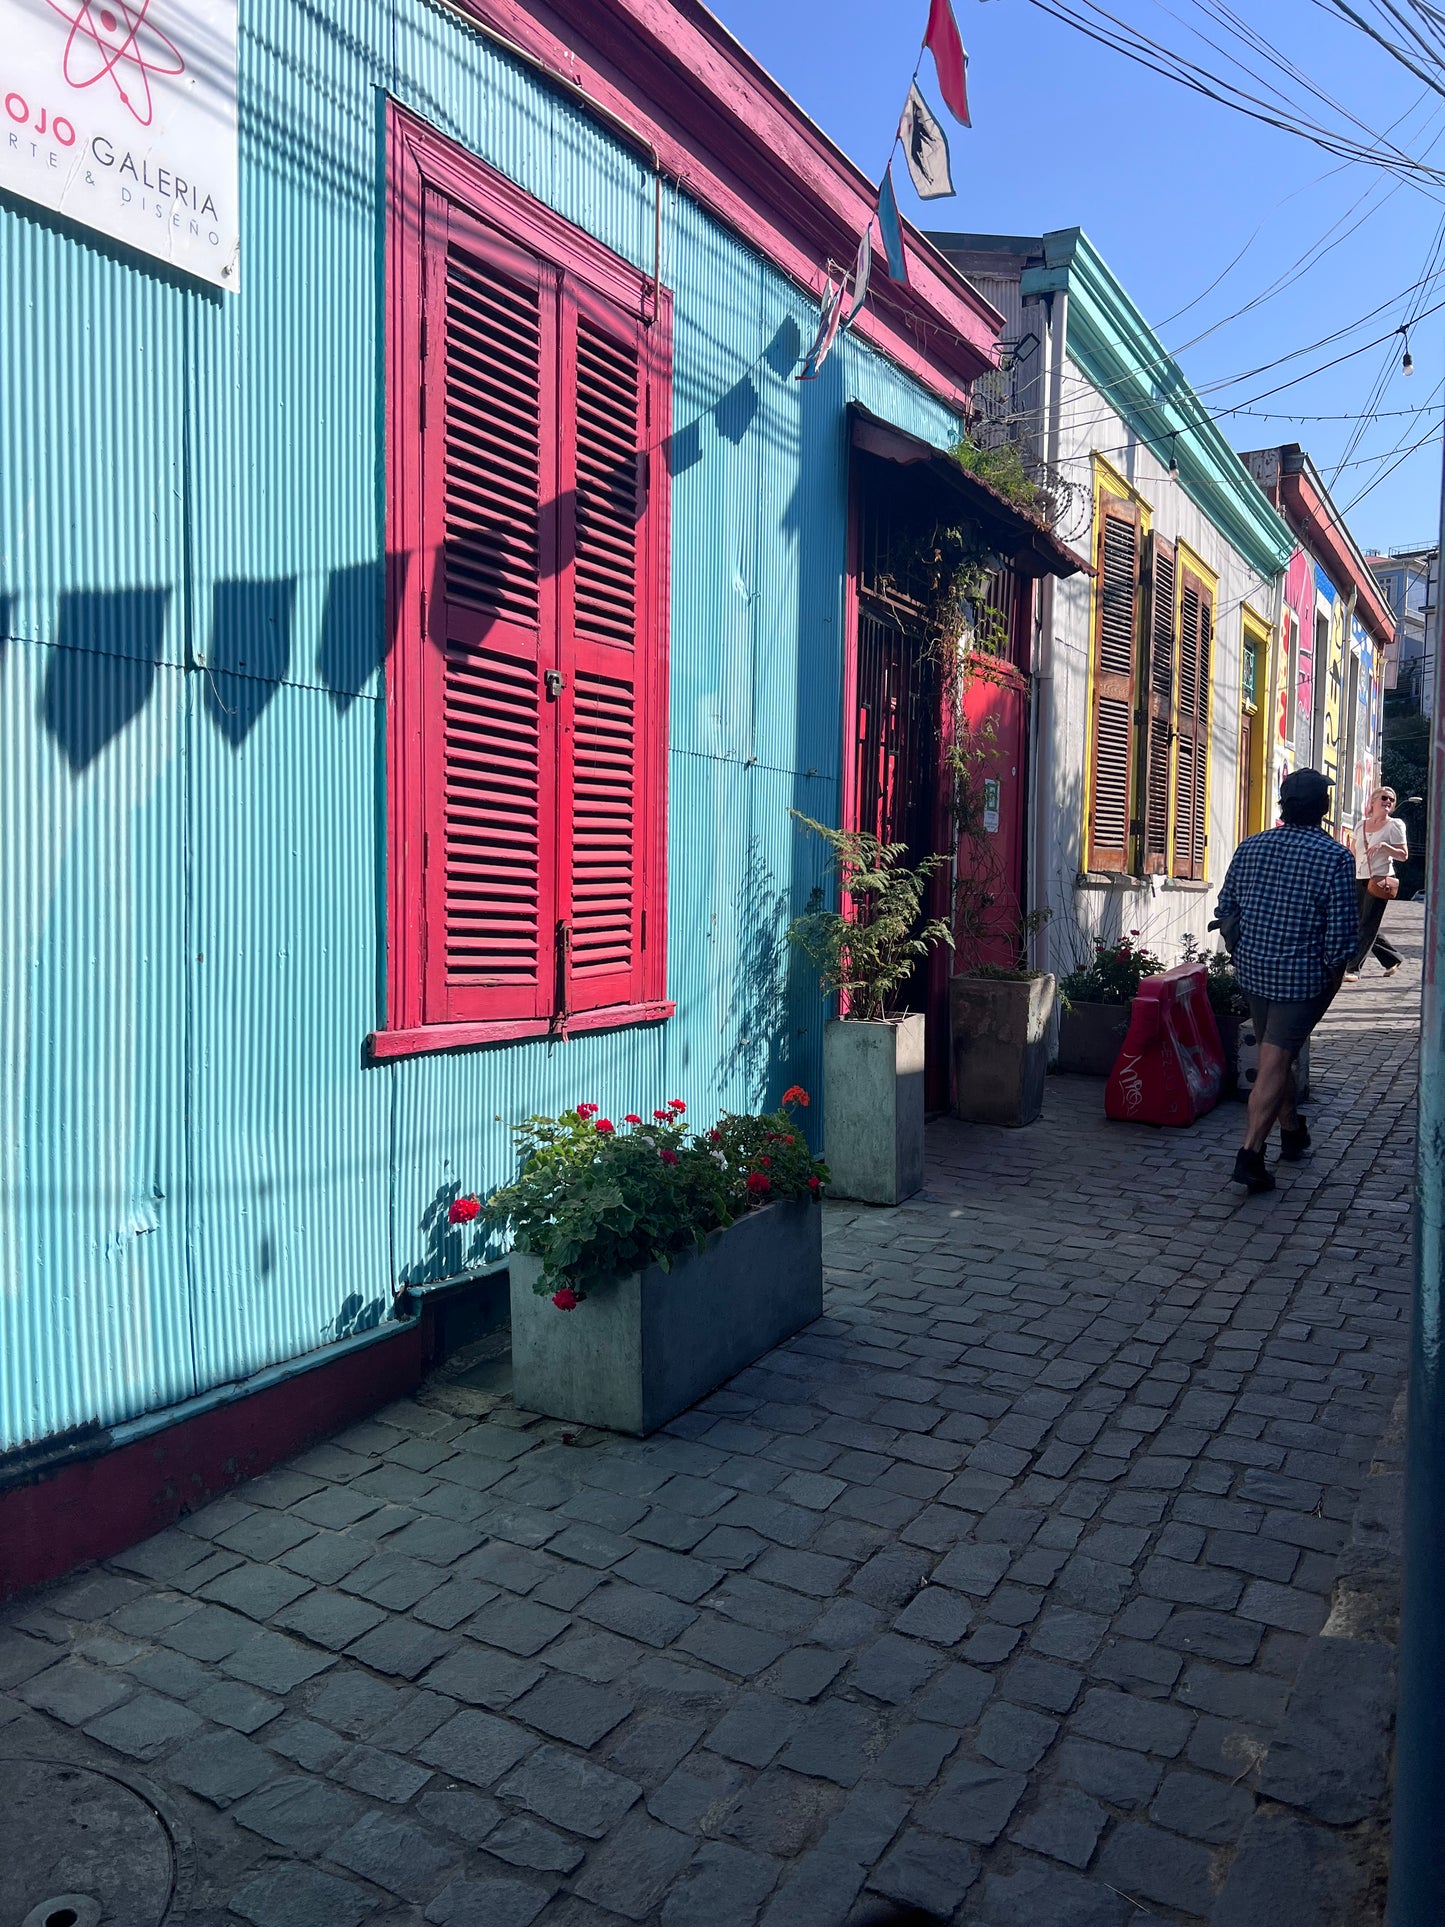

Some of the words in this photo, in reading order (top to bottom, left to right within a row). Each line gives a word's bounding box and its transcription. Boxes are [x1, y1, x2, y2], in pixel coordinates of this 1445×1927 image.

[5, 92, 76, 146] OJO
[92, 136, 218, 222] GALERIA
[85, 170, 95, 186] &
[121, 187, 219, 246] DISEÑO
